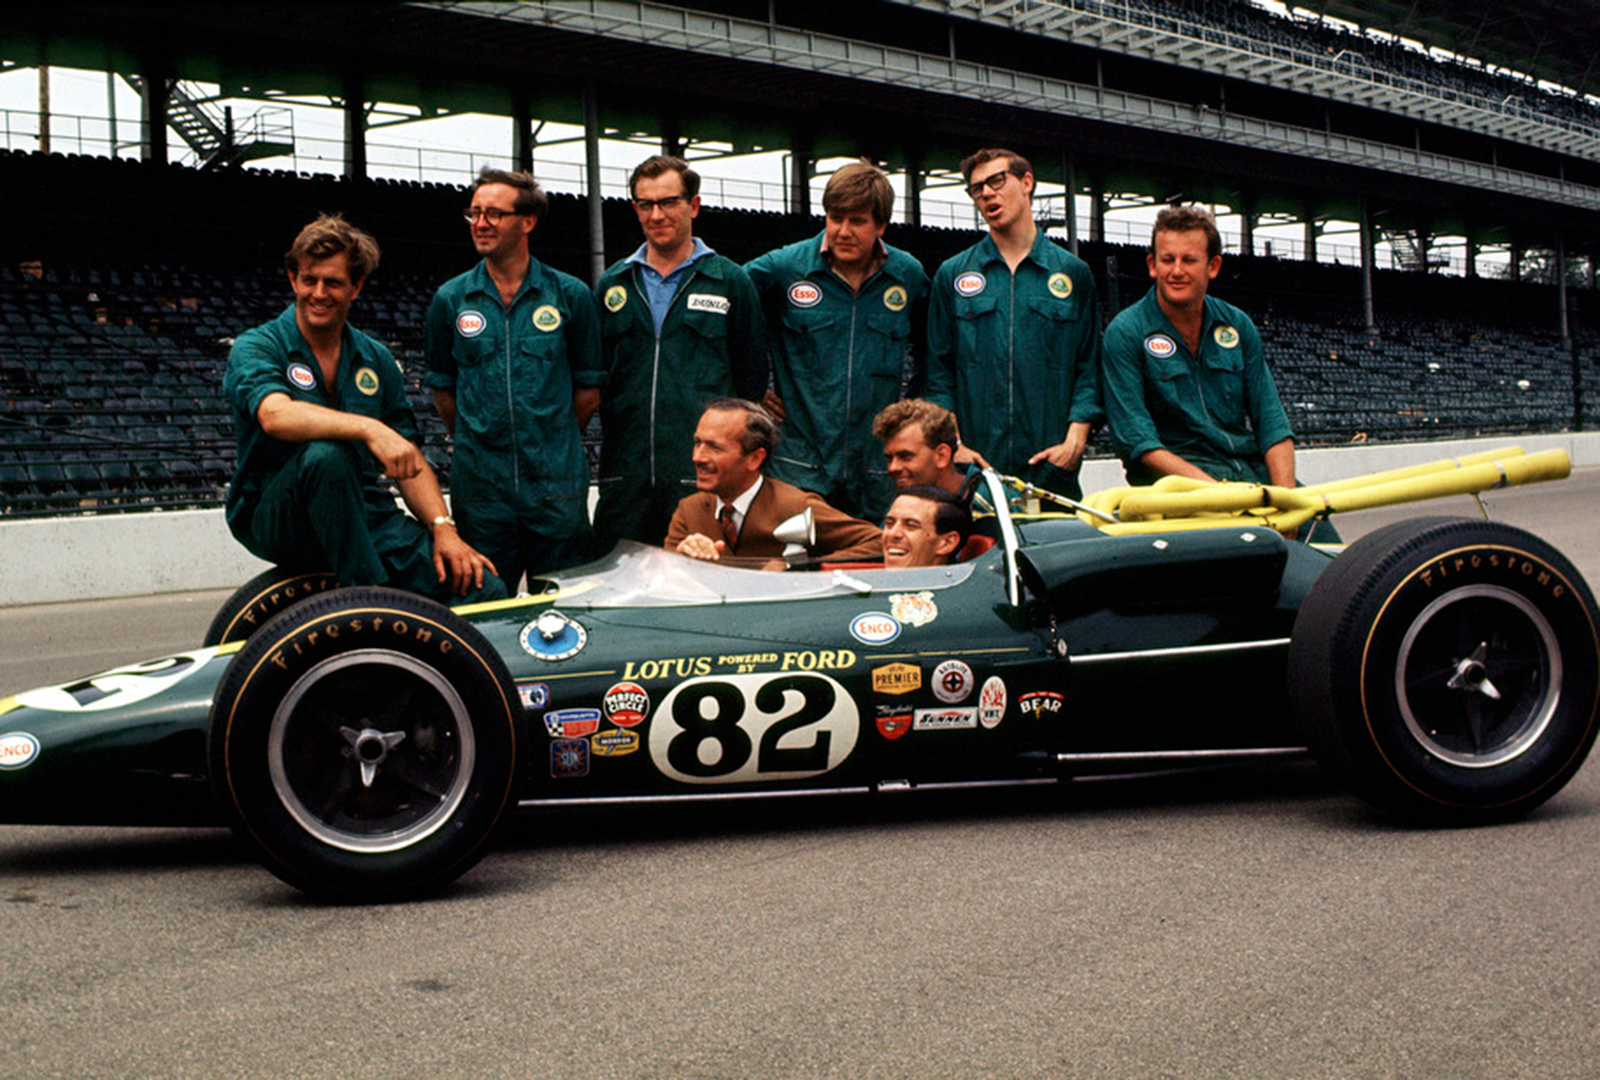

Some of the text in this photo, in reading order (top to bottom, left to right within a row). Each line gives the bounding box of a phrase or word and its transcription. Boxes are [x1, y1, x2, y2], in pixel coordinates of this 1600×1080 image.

[794, 288, 817, 299] Esso
[460, 318, 481, 330] Esso
[1420, 553, 1565, 598] Firestone
[860, 621, 893, 634] ENCO
[271, 617, 453, 670] Firestone
[621, 649, 857, 680] LOTUS POWERED BY FORD
[875, 671, 920, 686] PREMIER
[605, 691, 646, 705] PERFECT
[608, 701, 645, 713] CIRCLE
[1020, 698, 1063, 714] BEAR
[667, 675, 836, 778] 82
